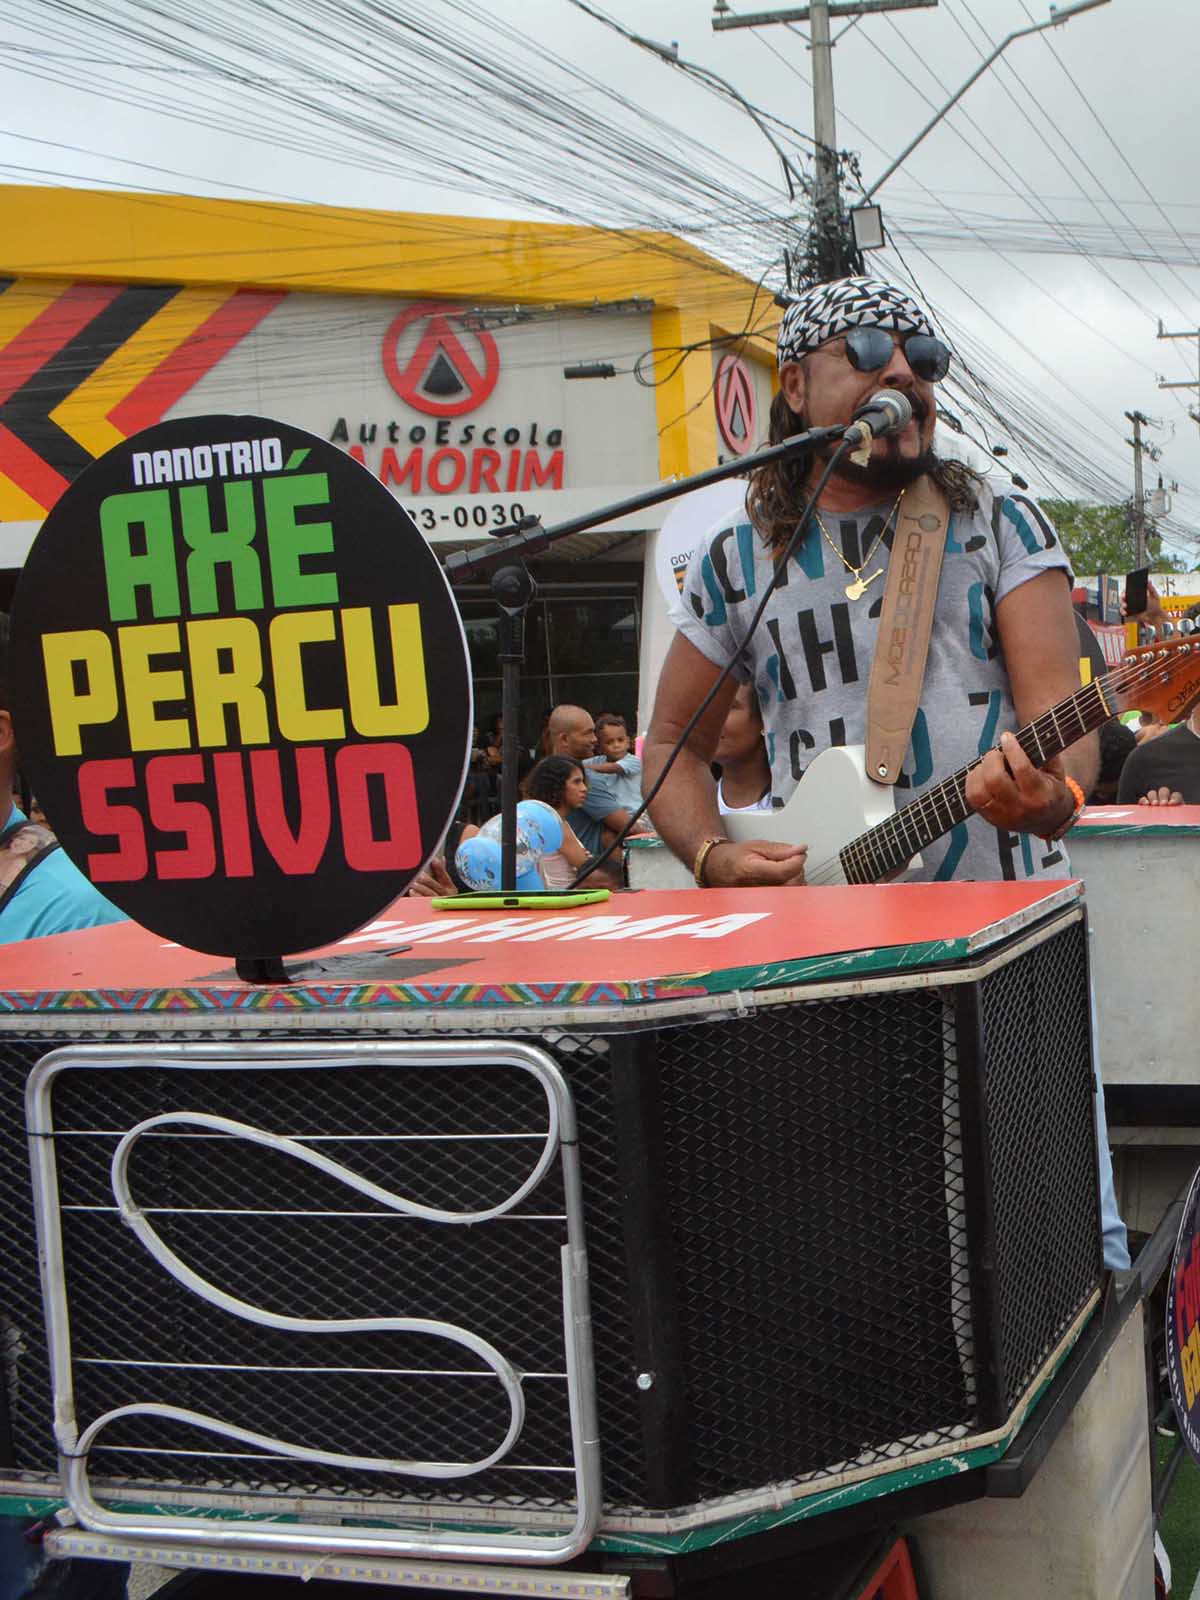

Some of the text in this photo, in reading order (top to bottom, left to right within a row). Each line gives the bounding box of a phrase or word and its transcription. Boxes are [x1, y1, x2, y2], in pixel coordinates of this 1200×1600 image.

[132, 437, 283, 486] NANOTRIO
[331, 417, 563, 446] AutoEscola
[99, 448, 340, 622] AXÉ
[407, 503, 525, 530] 3-0030
[41, 603, 430, 756] PERCU
[77, 742, 423, 882] SSIVO
